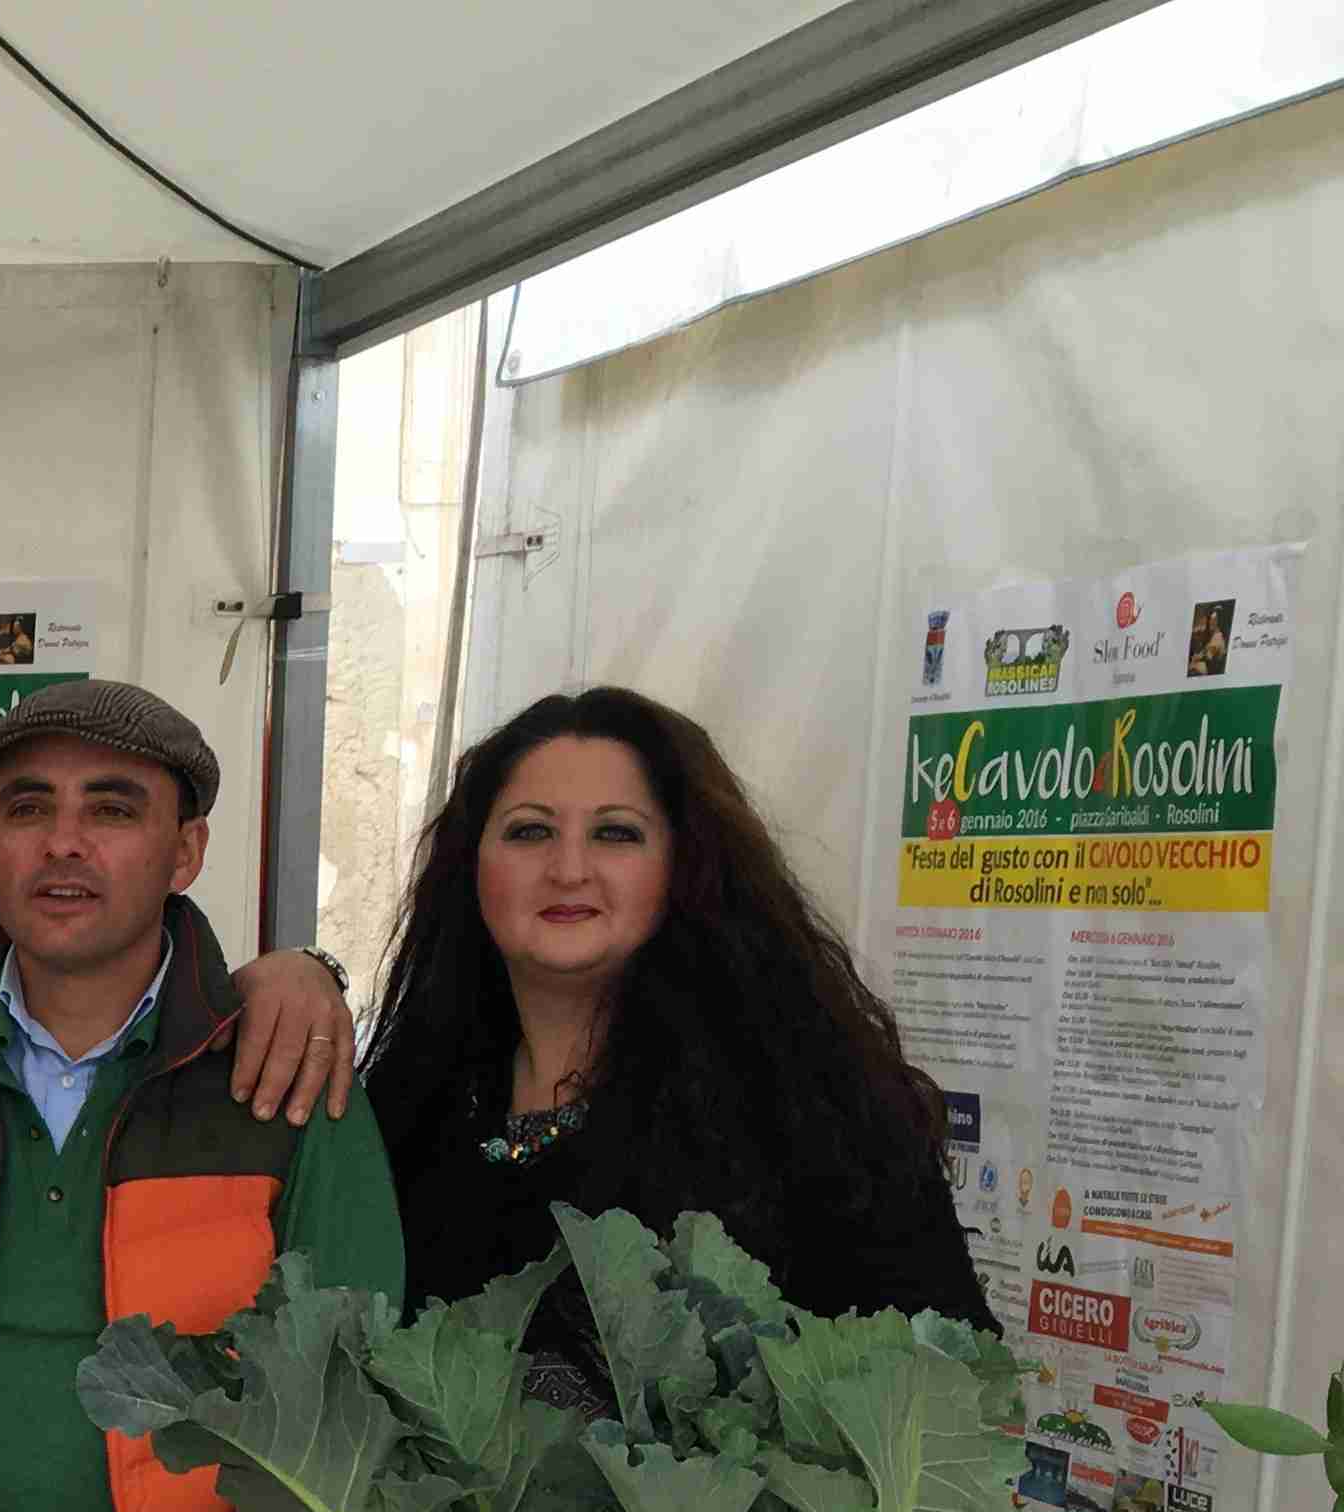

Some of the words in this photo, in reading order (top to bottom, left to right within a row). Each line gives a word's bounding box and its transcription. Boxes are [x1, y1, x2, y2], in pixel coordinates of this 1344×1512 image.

[930, 809, 938, 831] 5
[947, 809, 957, 831] 6
[960, 811, 1013, 834] gennaio
[1016, 808, 1048, 829] 2016
[1167, 801, 1220, 825] Rosolini
[950, 843, 974, 870] del
[981, 846, 1031, 875] gusto
[1033, 848, 1069, 870] con
[1074, 842, 1086, 869] il
[1155, 837, 1262, 869] VECCHIO
[970, 877, 990, 903] di
[994, 877, 1065, 904] Rosolini
[1068, 884, 1081, 904] e
[1039, 1287, 1115, 1327] CICERO
[1039, 1315, 1113, 1345] GIOIELLI
